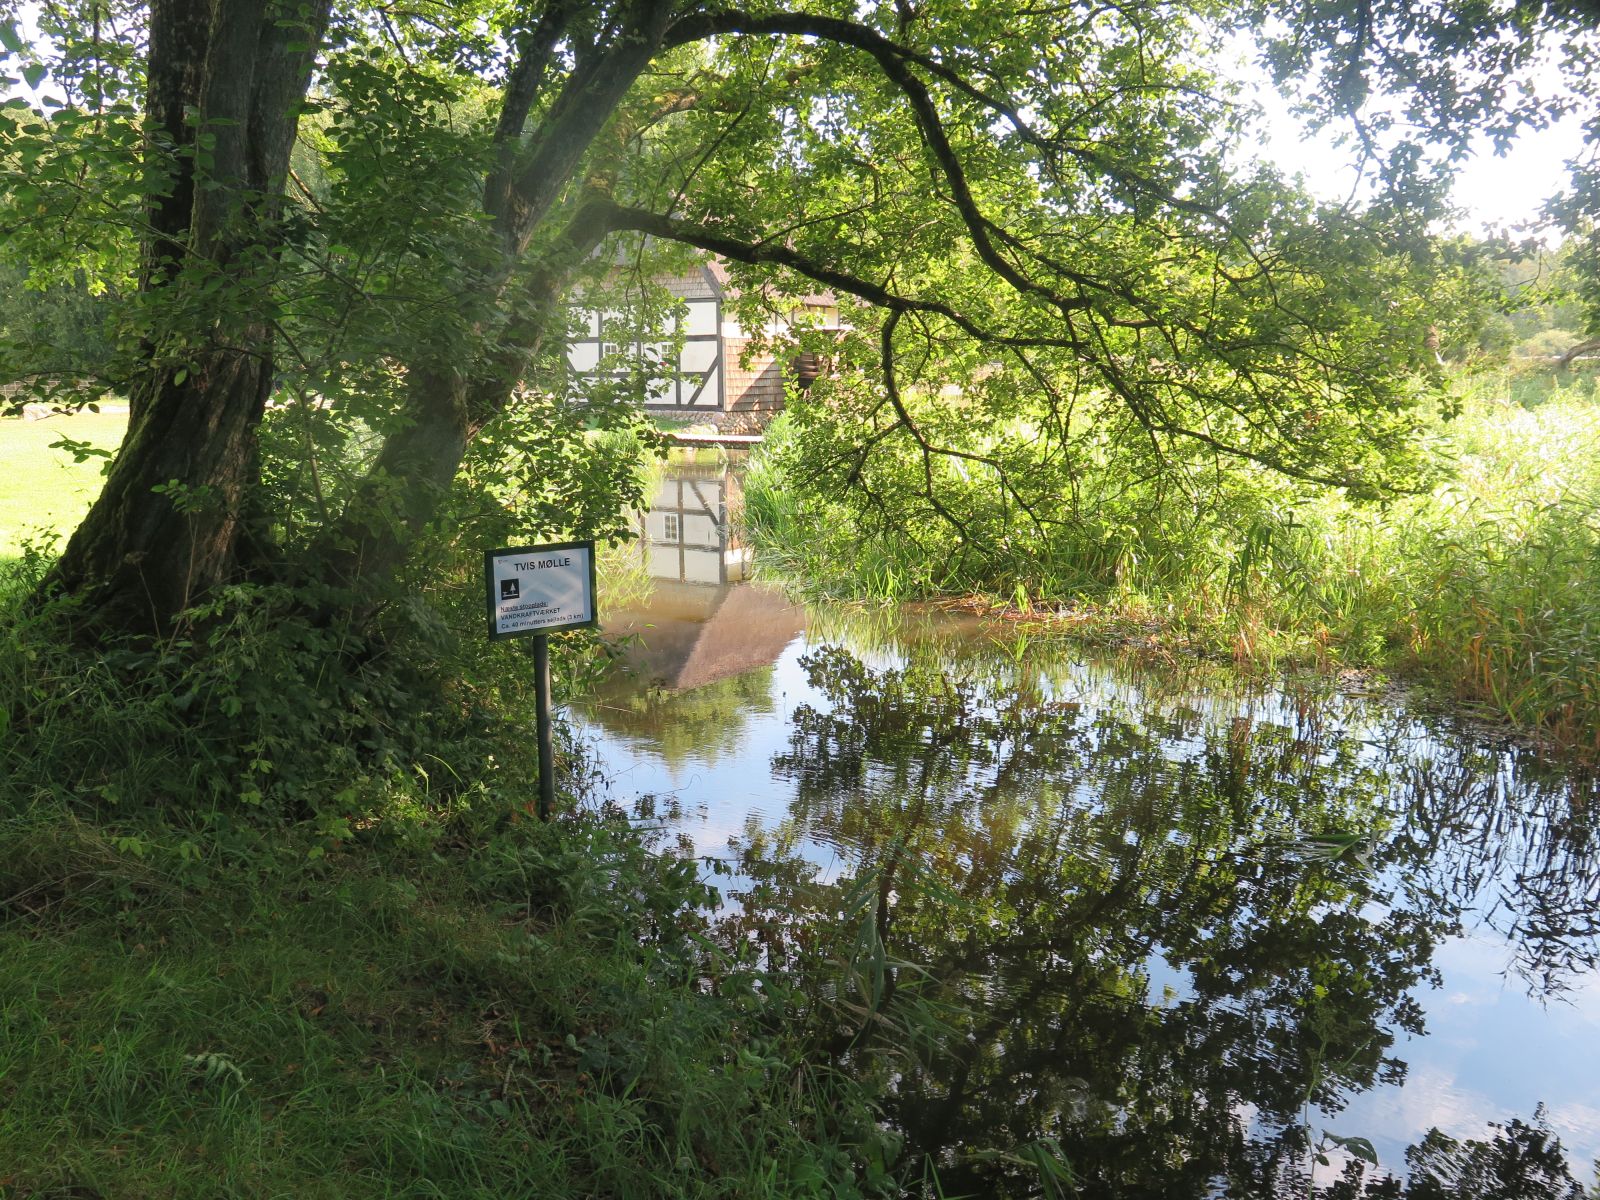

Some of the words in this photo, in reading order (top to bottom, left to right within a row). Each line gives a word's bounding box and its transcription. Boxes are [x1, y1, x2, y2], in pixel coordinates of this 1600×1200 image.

[514, 562, 535, 571] TVIS
[538, 558, 570, 568] MØLLE
[501, 608, 560, 620] VANDKRAFTVÆRKET
[519, 619, 545, 627] minutters
